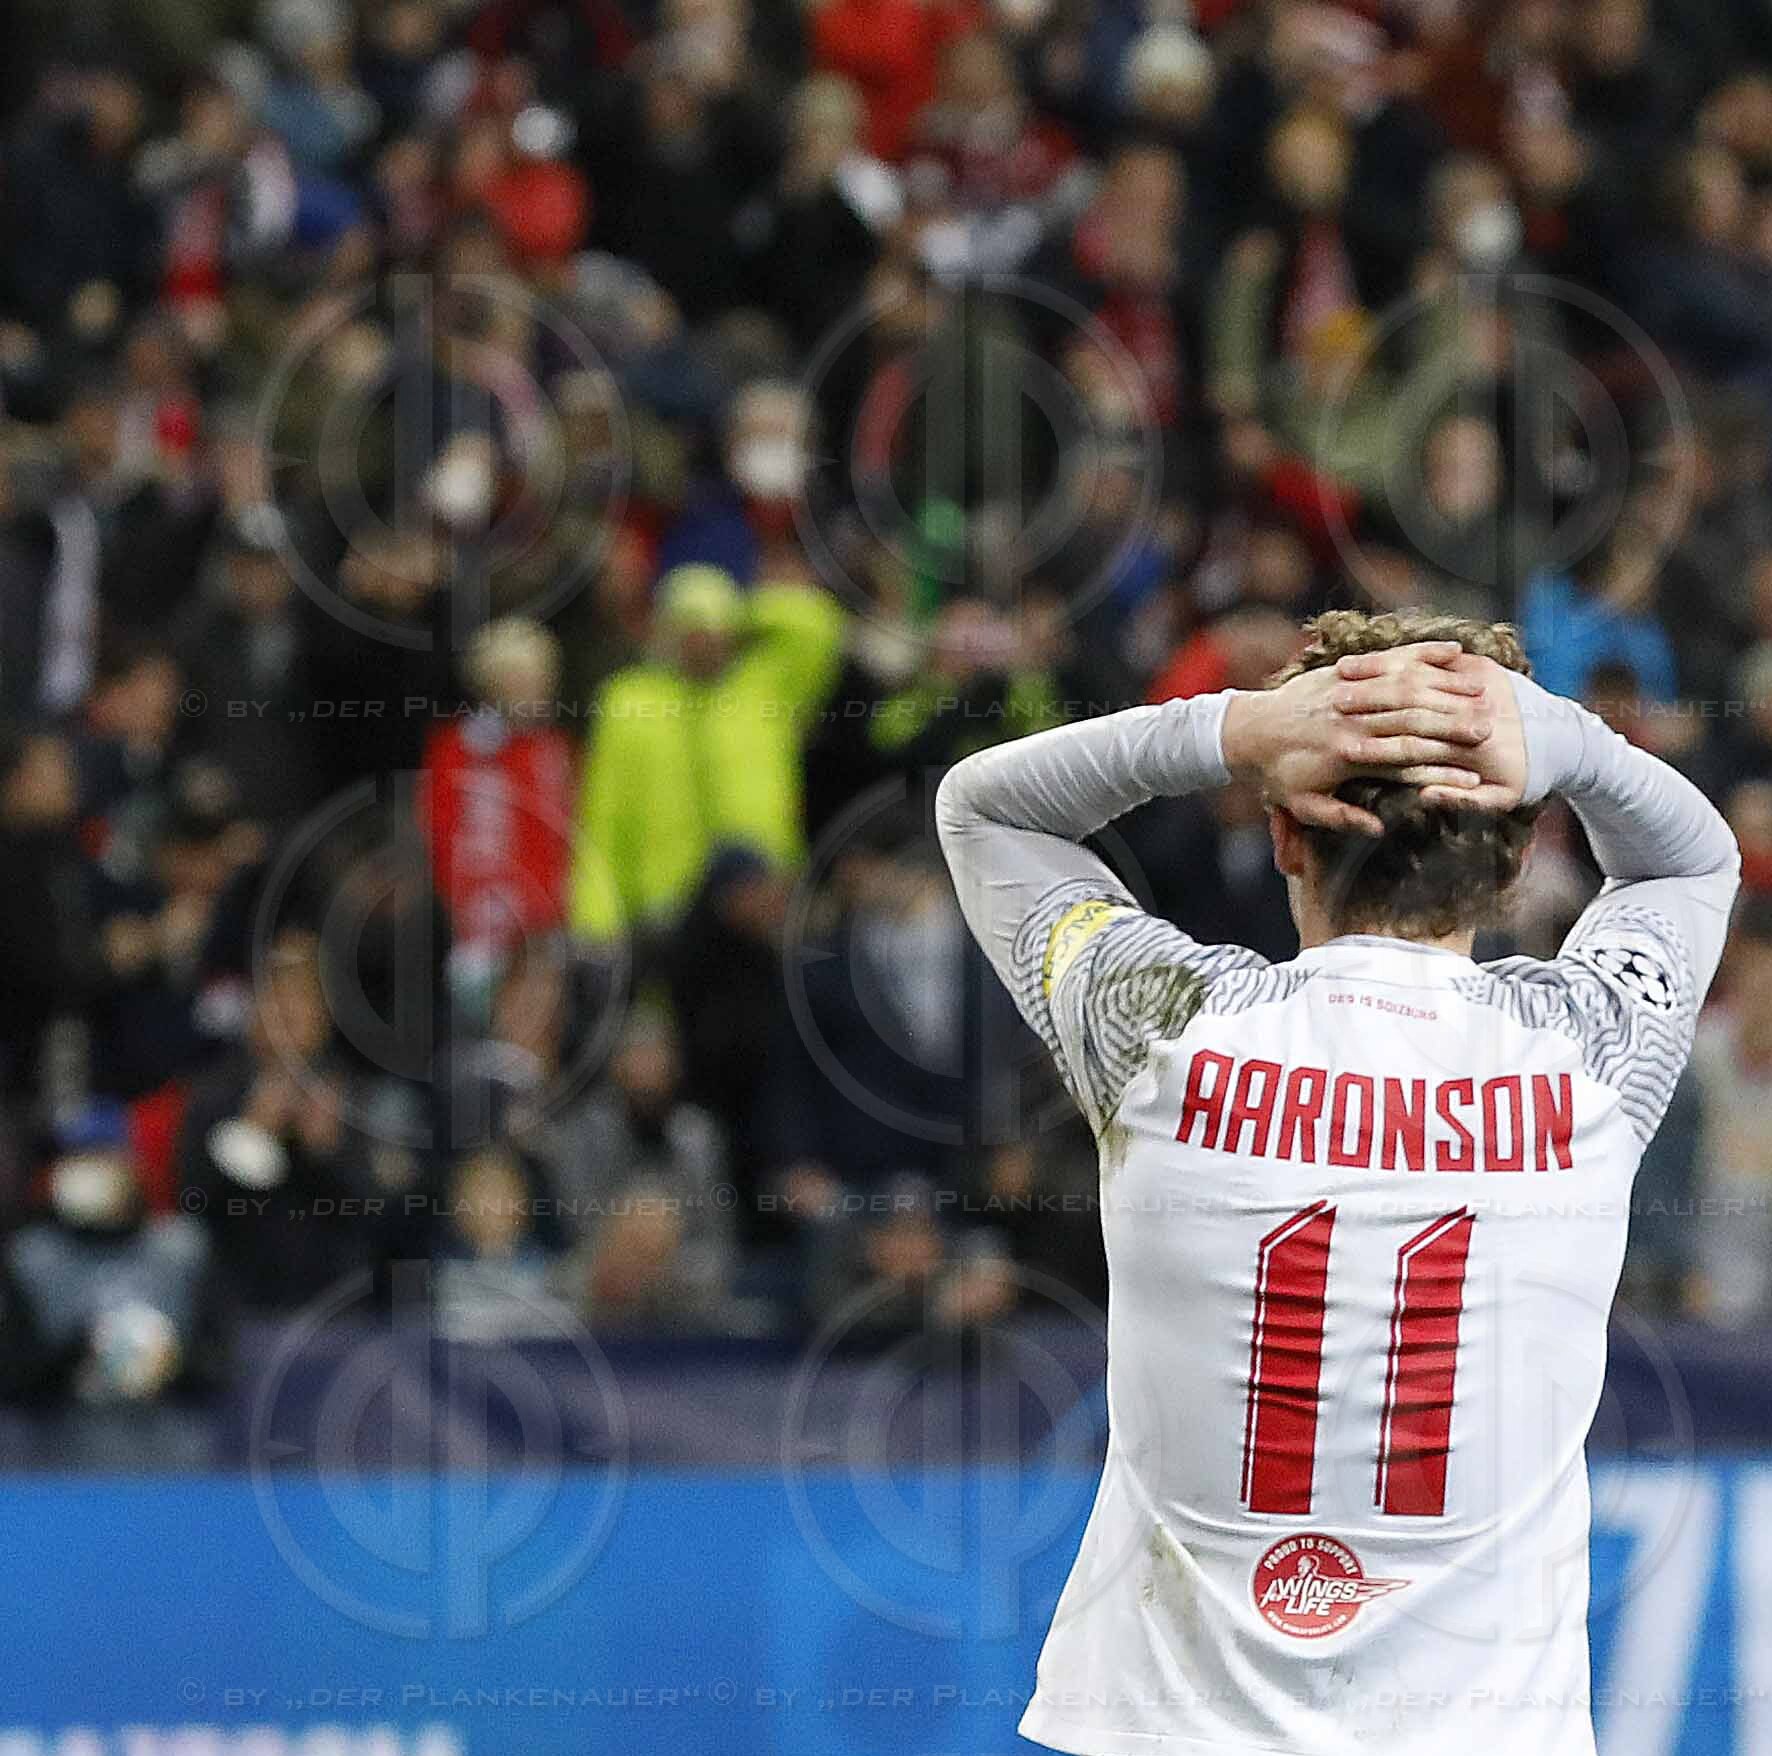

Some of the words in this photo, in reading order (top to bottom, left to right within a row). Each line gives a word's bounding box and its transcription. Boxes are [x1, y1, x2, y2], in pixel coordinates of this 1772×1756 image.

[1176, 1049, 1573, 1173] AARONSON
[1241, 1199, 1478, 1515] 11
[1264, 1540, 1298, 1571] PROUD
[1300, 1538, 1314, 1549] TO
[1277, 1575, 1358, 1600] WINGS
[1284, 1596, 1335, 1615] LIFE
